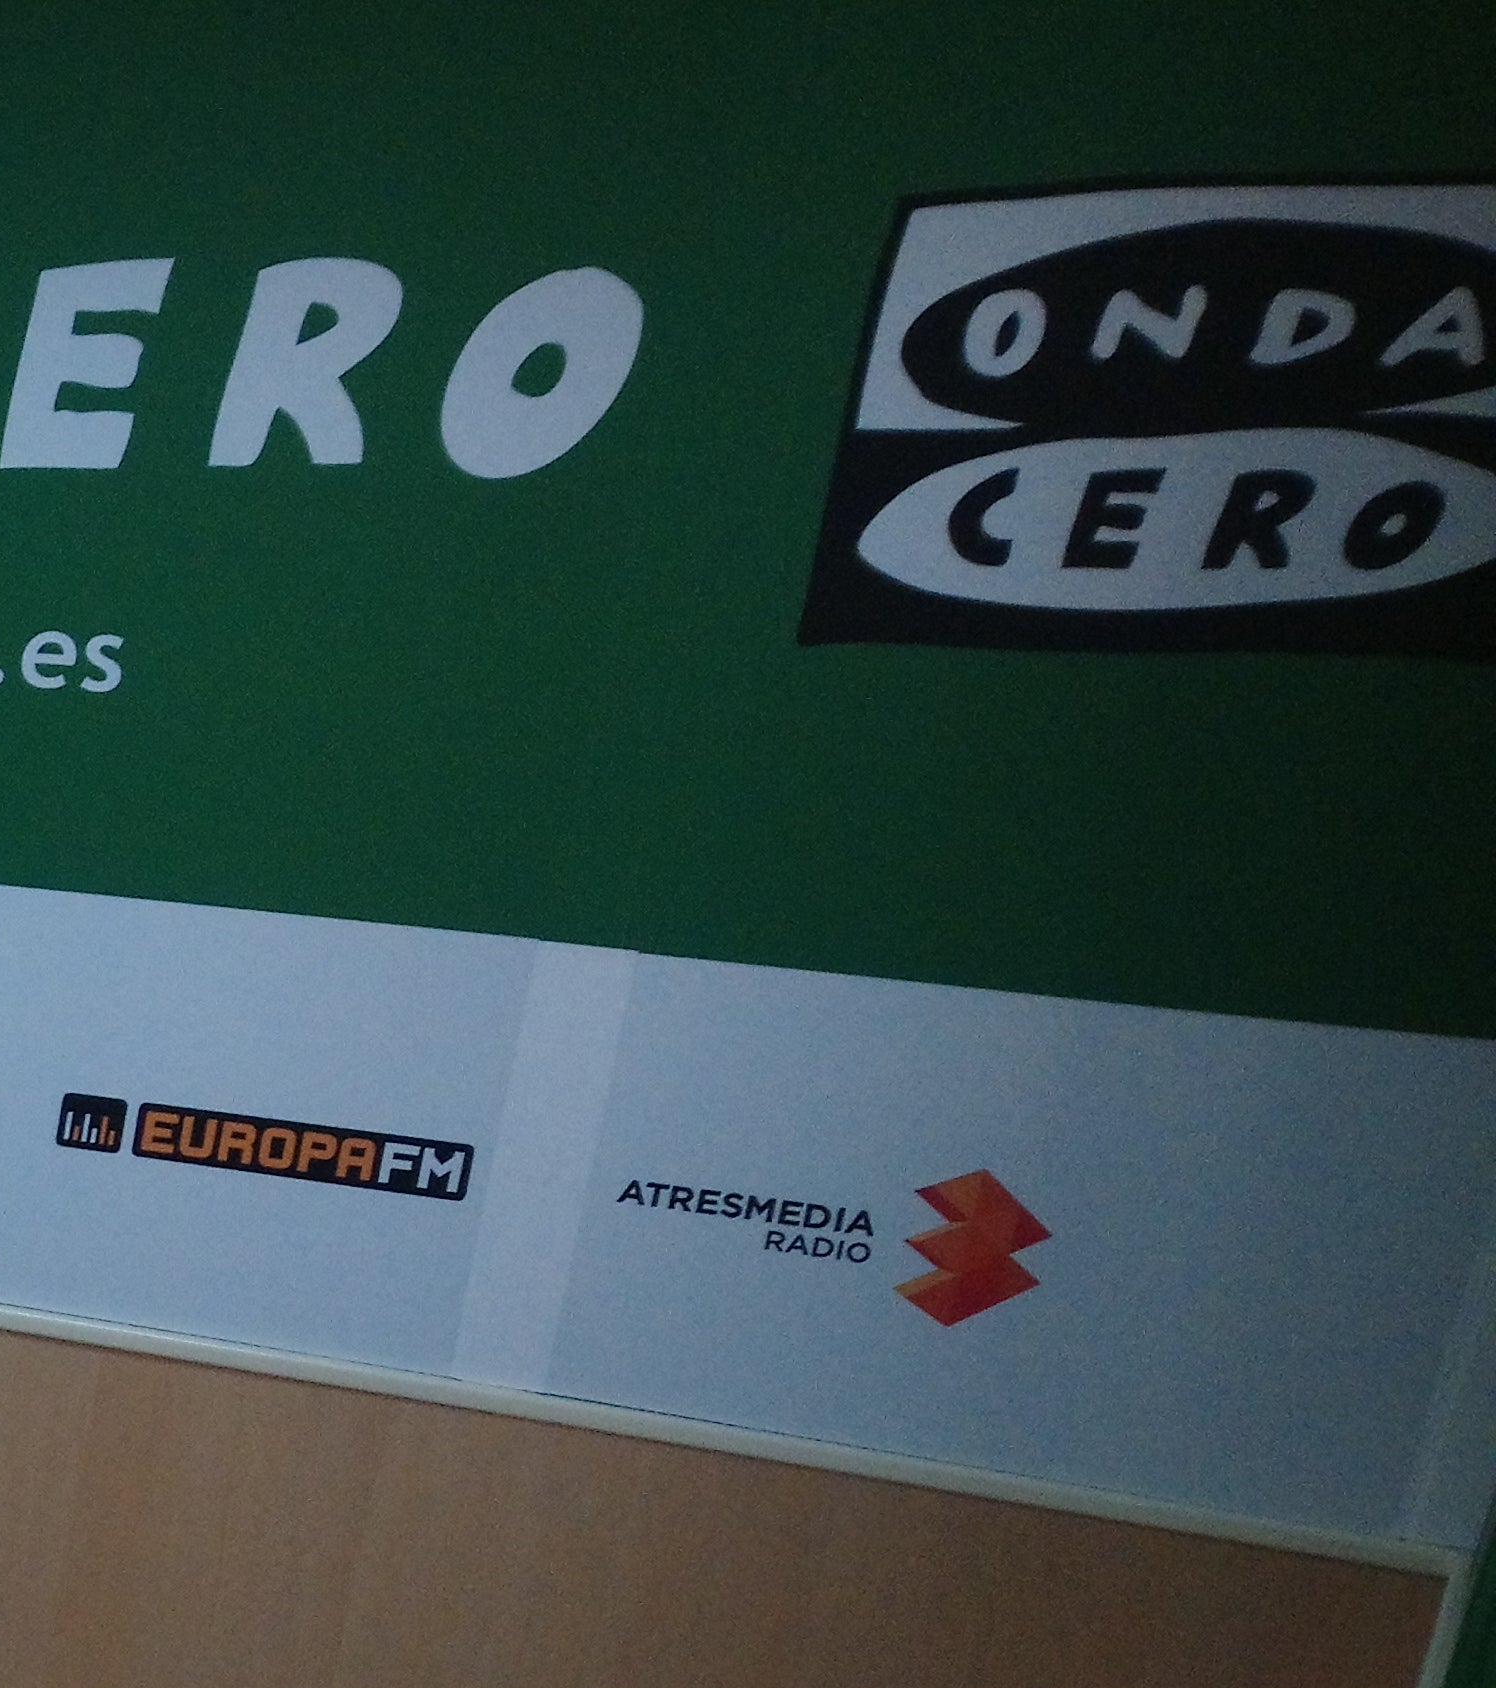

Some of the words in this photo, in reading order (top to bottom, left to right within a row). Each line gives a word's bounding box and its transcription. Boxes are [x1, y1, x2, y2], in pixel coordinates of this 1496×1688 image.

[962, 284, 1485, 379] ONDA
[946, 466, 1448, 572] CERO
[616, 1179, 874, 1237] ATRESMEDIA
[763, 1230, 872, 1264] RADIO
